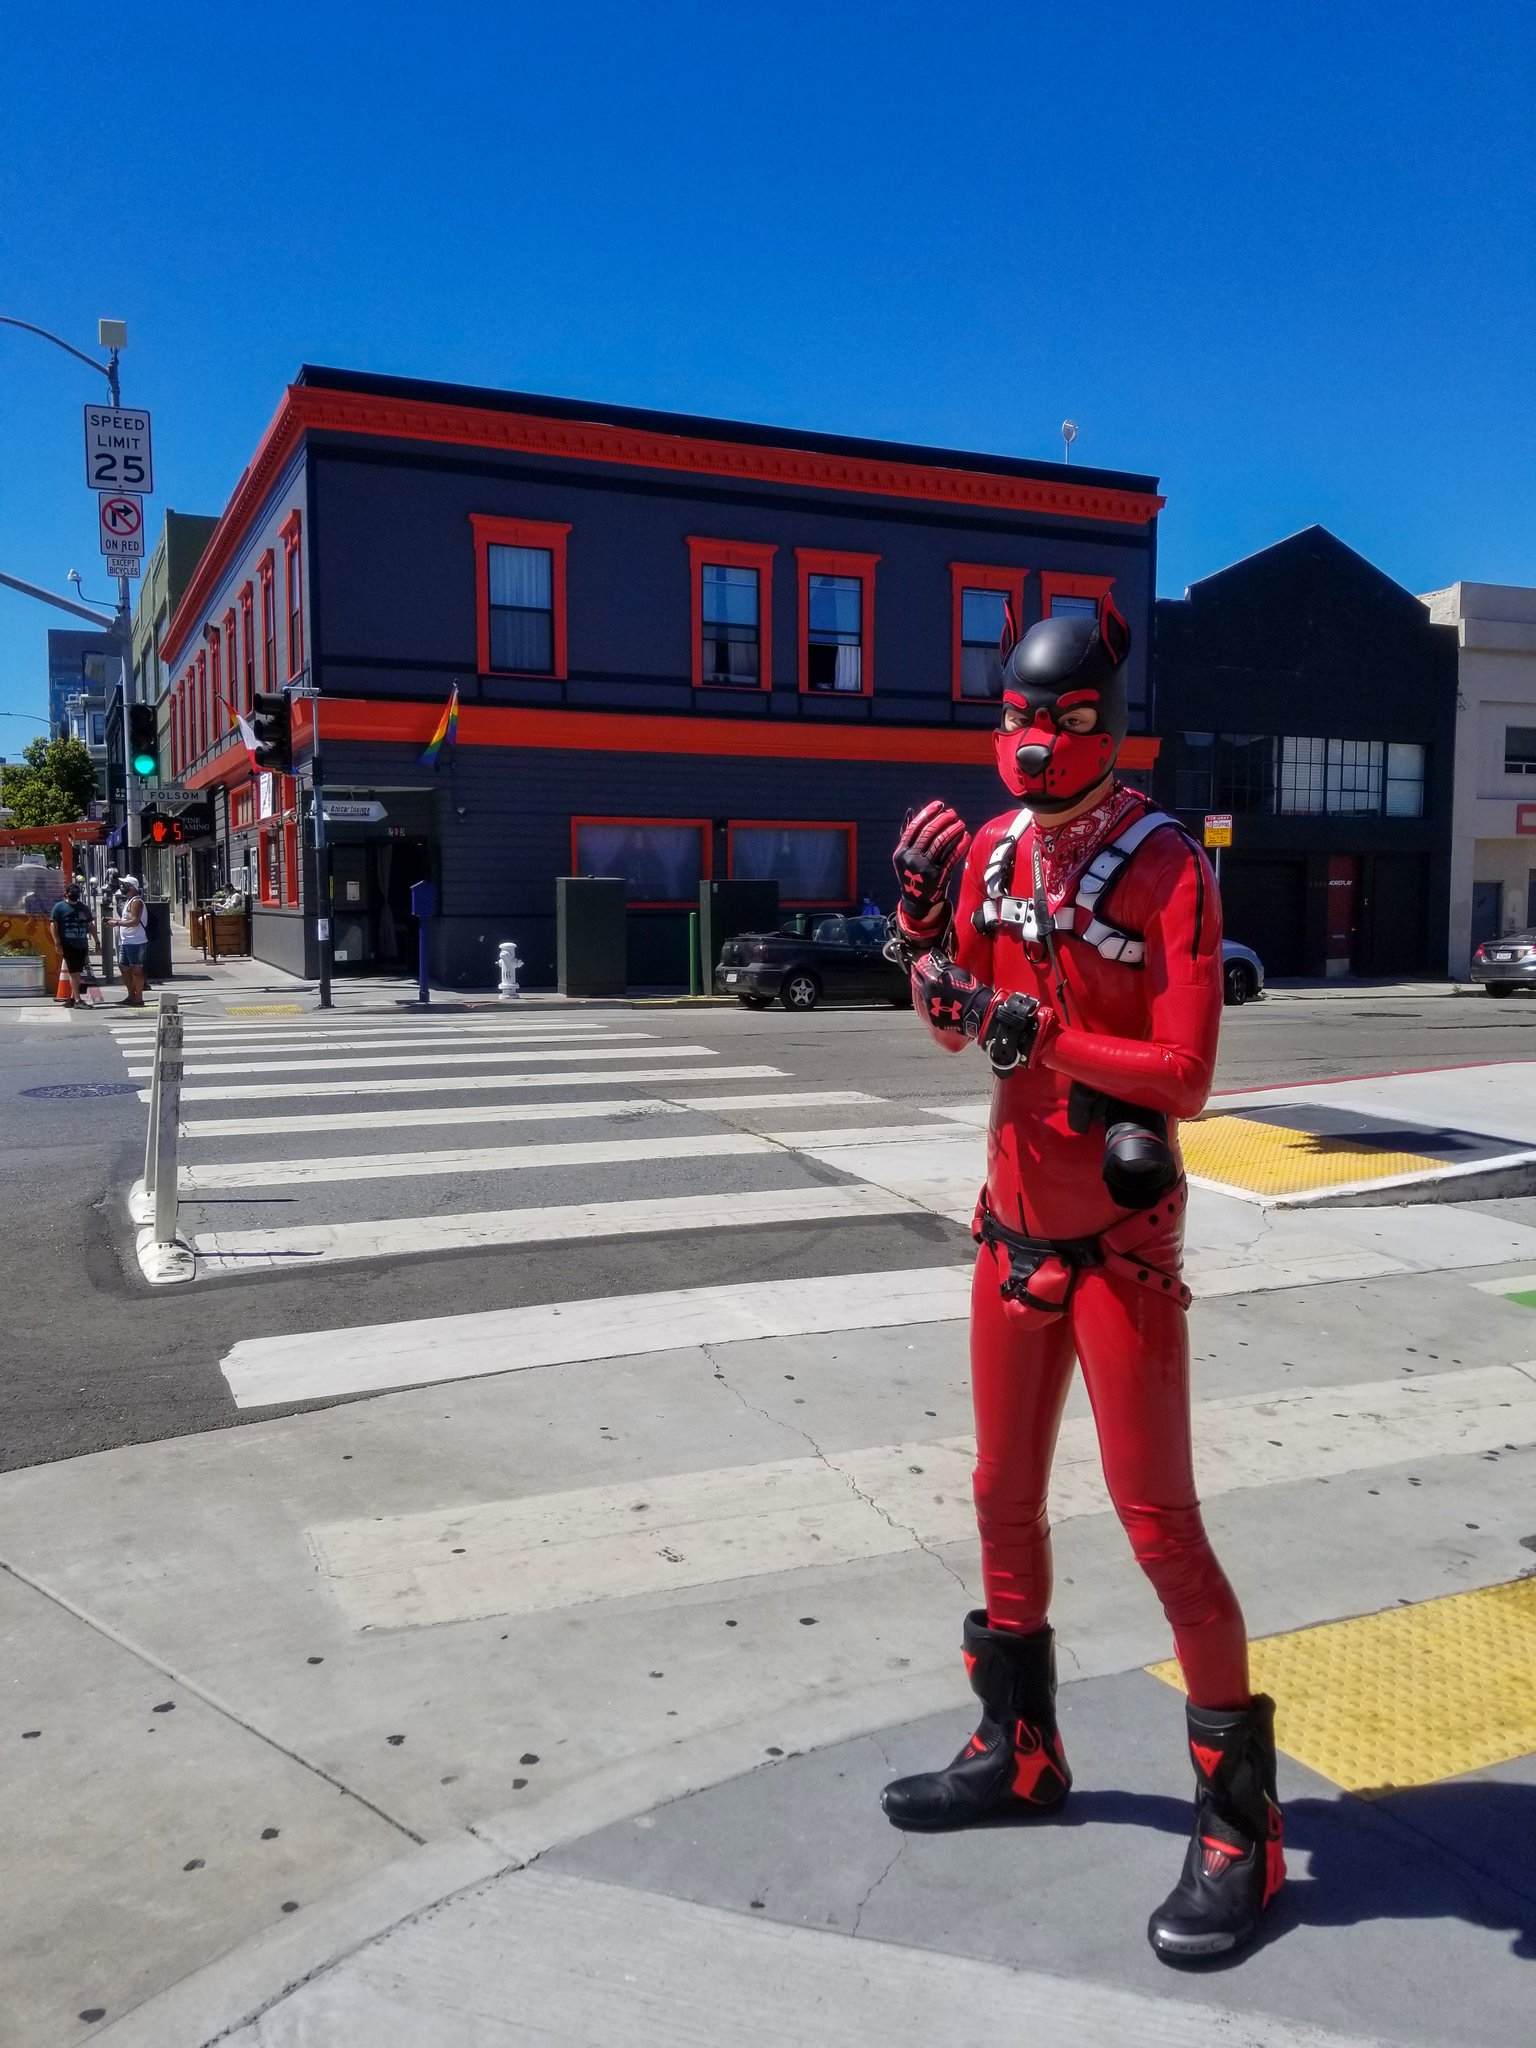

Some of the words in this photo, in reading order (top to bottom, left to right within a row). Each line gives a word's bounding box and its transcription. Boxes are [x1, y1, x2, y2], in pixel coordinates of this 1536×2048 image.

[90, 414, 145, 431] SPEED
[97, 434, 141, 450] LIMIT
[94, 453, 145, 483] 25
[105, 539, 118, 550] ON
[121, 541, 140, 551] RED
[109, 566, 139, 576] BICYCLES
[112, 559, 135, 567] EXCEPT
[150, 791, 199, 800] FOLSOM
[173, 823, 182, 840] 5
[1033, 851, 1042, 889] Canon
